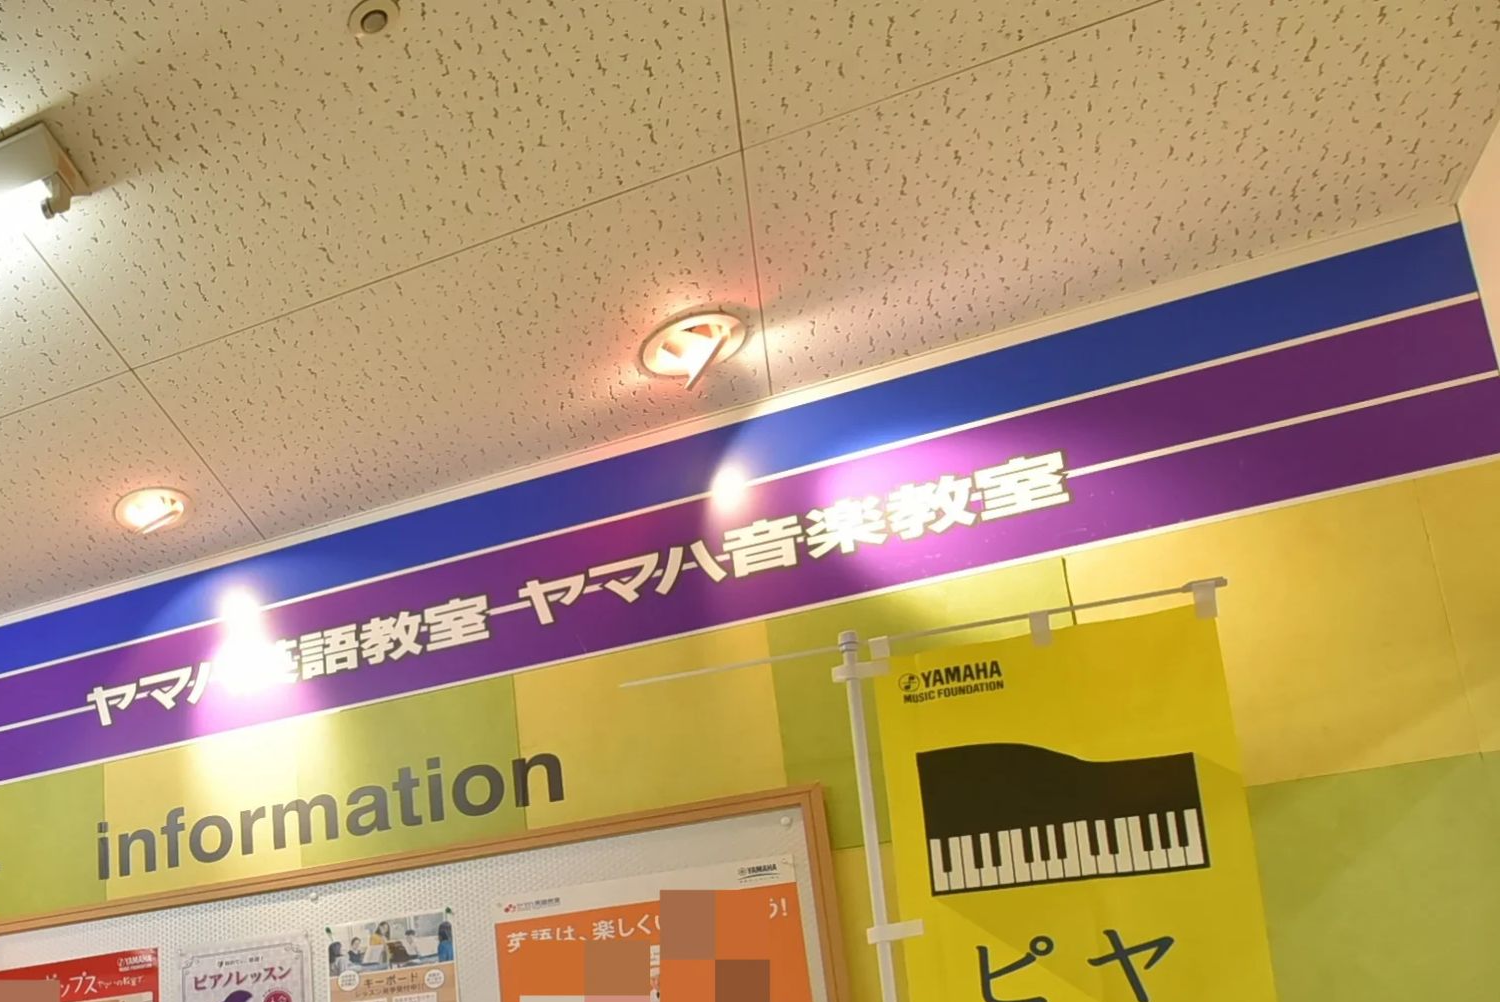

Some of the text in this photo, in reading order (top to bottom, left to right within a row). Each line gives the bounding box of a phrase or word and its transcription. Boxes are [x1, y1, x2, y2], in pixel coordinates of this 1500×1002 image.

[519, 451, 1070, 625] ヤマハ音楽教室
[921, 660, 1002, 688] YAMAHA
[903, 680, 1004, 704] MUSIC FOUNDATION
[97, 751, 566, 881] information
[748, 863, 777, 874] YAMAHA
[194, 966, 292, 991] ピアノレッスン
